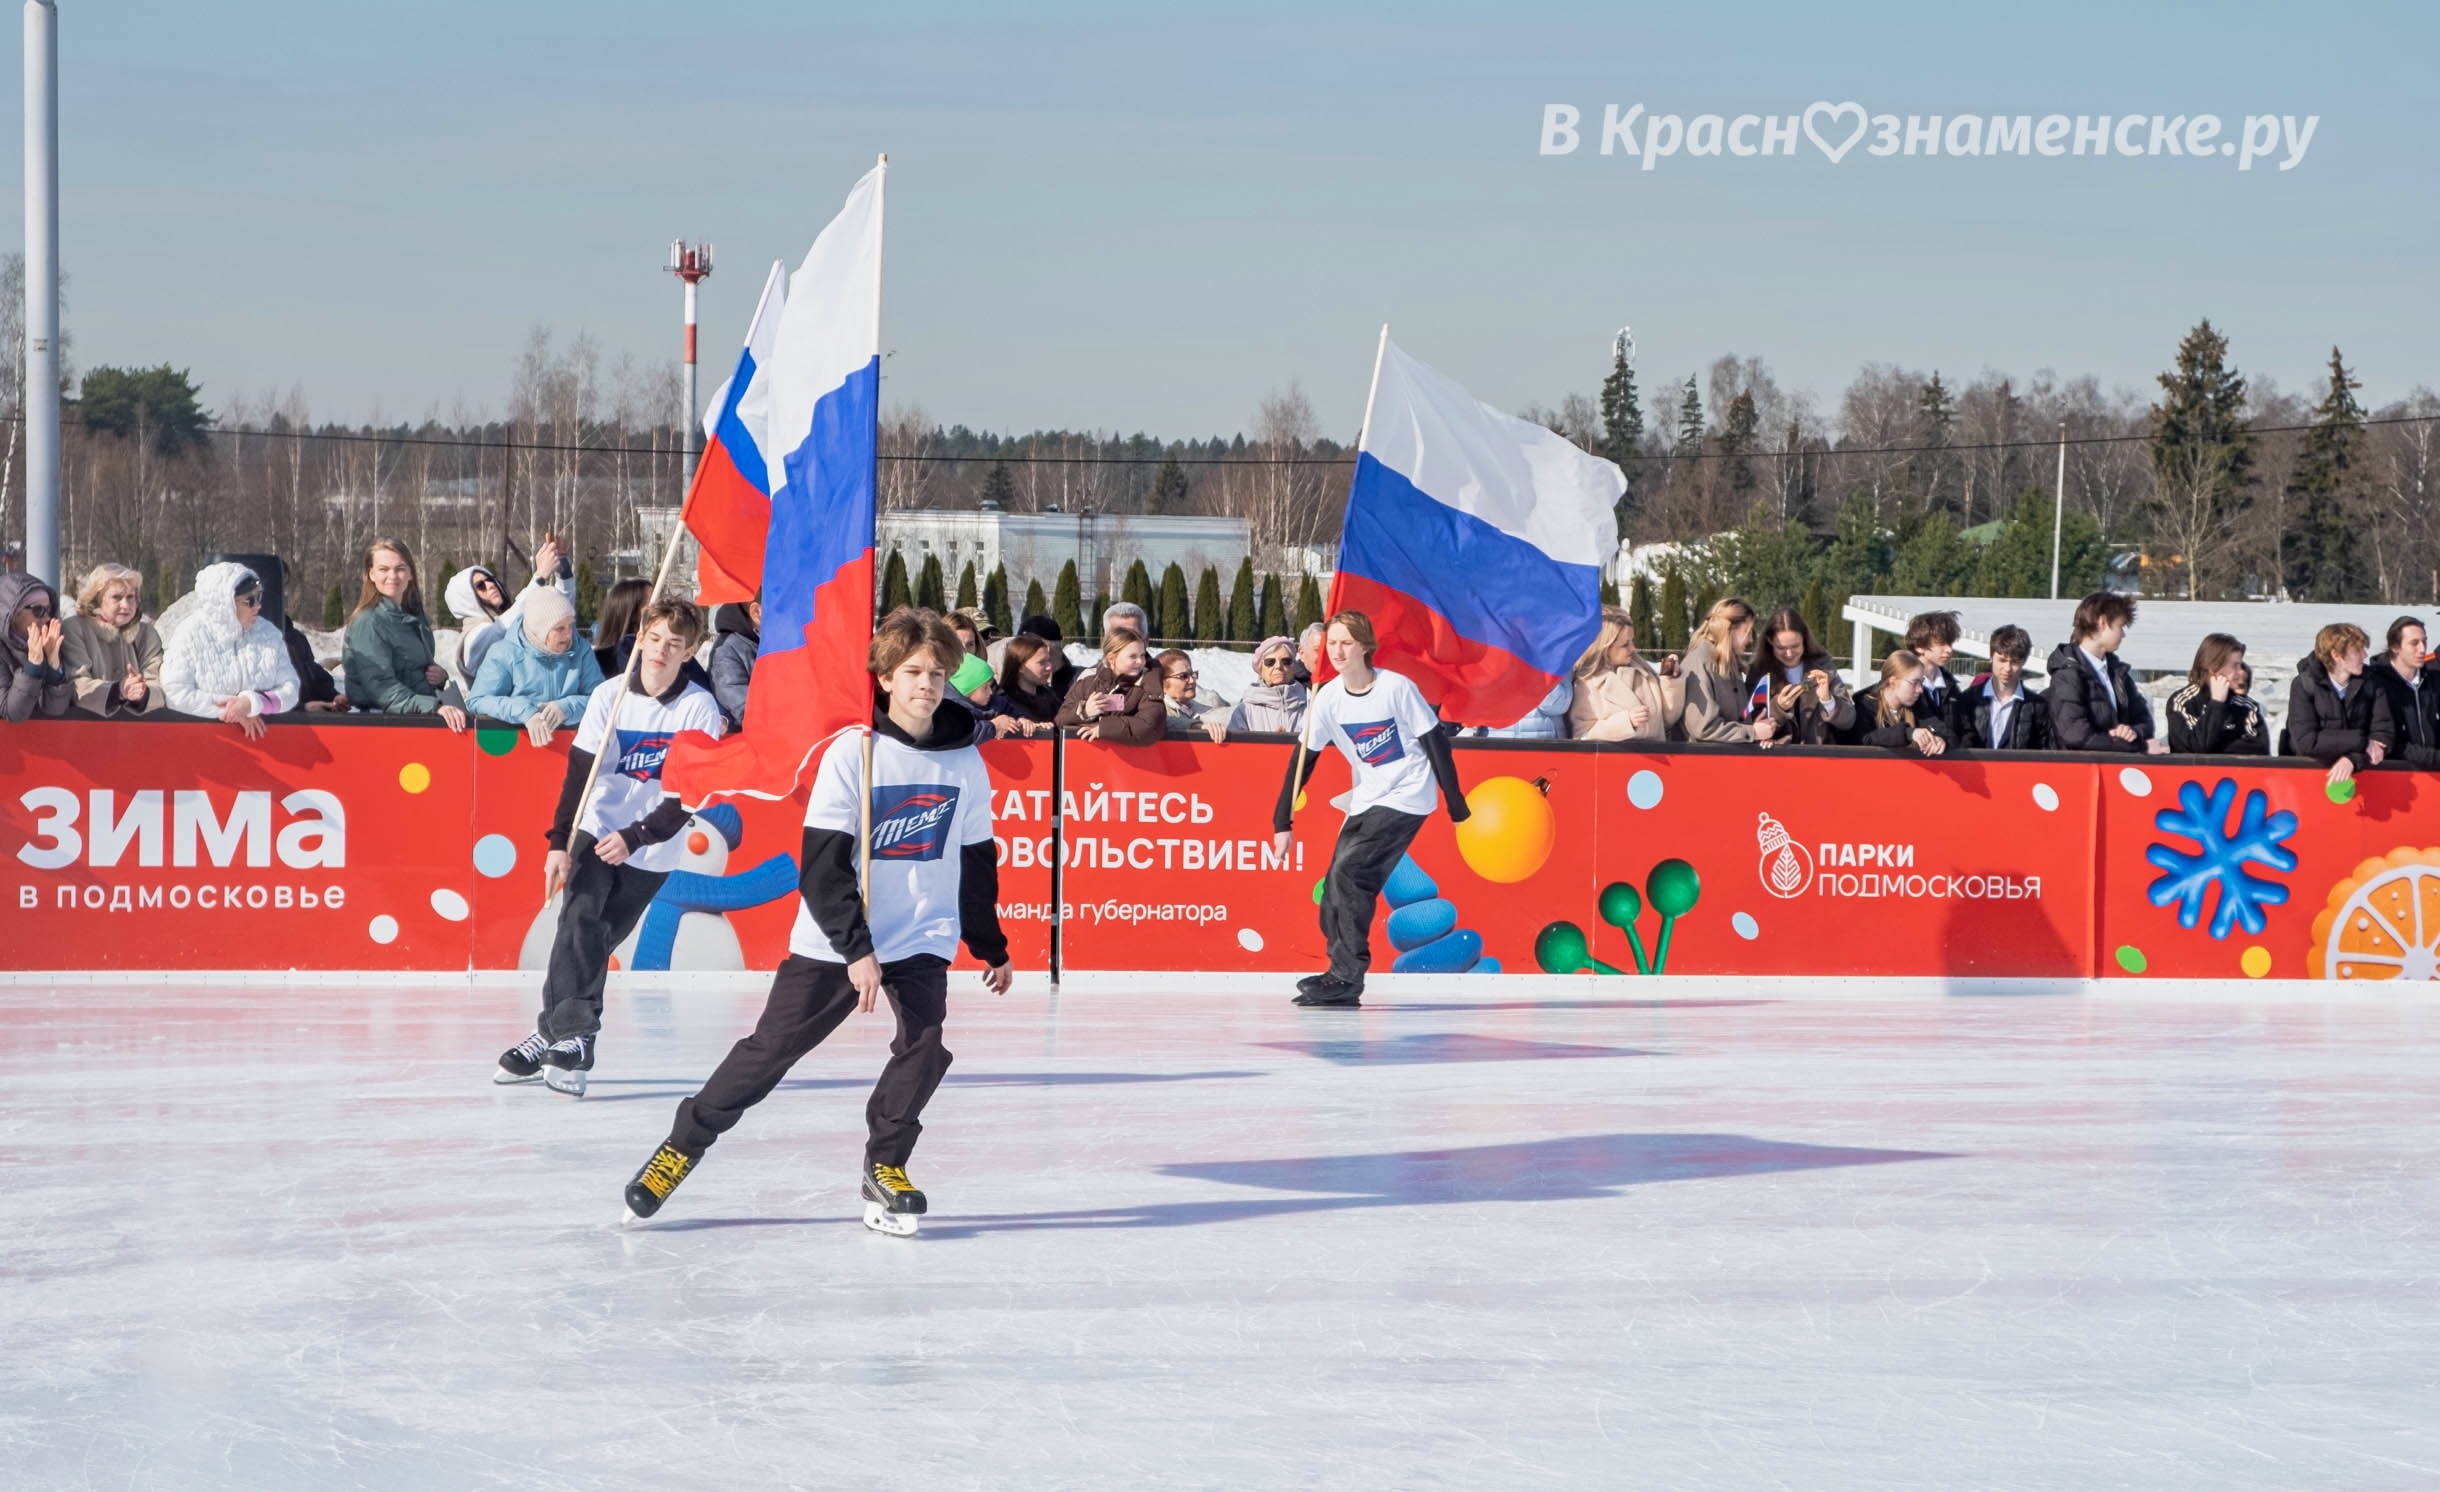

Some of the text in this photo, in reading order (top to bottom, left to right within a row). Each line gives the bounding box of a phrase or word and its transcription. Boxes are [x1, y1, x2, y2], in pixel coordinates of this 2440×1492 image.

[993, 835, 1304, 872] ОВОЛЬСТВИЕМ!
[1819, 843, 1914, 868] ПАРКИ
[57, 885, 346, 912] подмосковье
[1819, 873, 2041, 899] ПОДМОСКОВЬЯ
[996, 899, 1227, 927] манда губернатора
